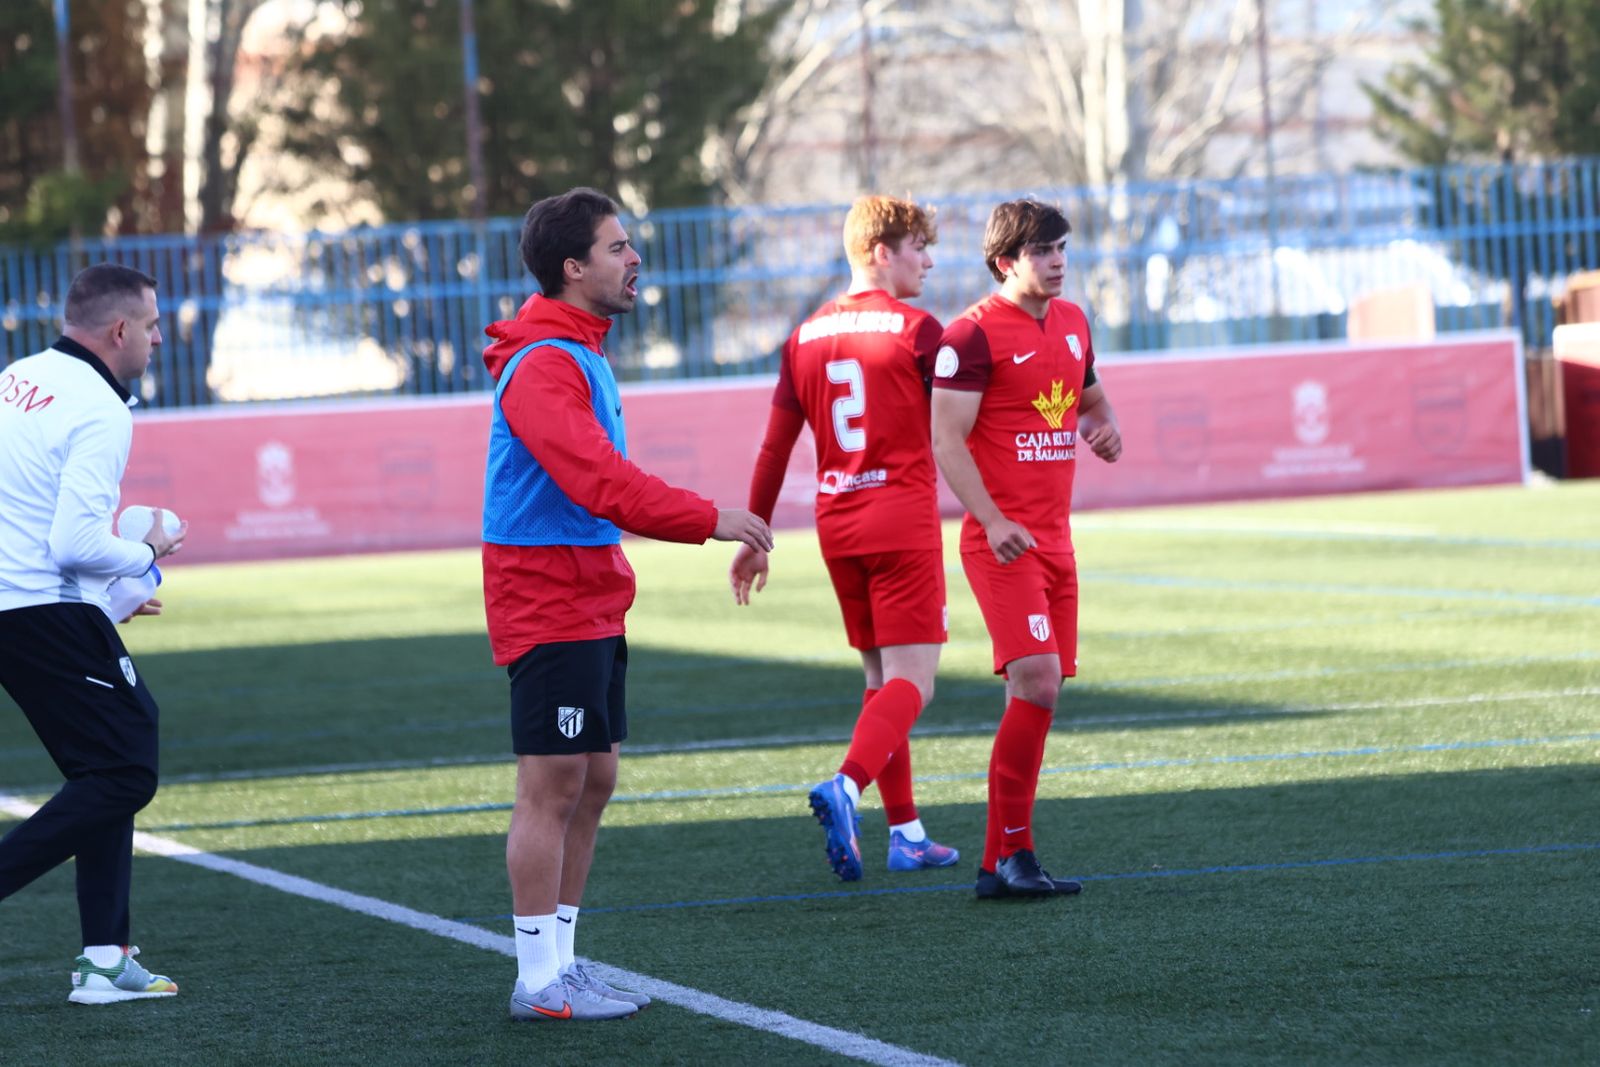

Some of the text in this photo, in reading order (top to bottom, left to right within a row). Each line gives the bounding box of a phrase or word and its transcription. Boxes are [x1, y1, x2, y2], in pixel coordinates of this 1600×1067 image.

[826, 358, 866, 452] 2
[1015, 433, 1051, 449] CAJA
[1018, 450, 1033, 462] DE
